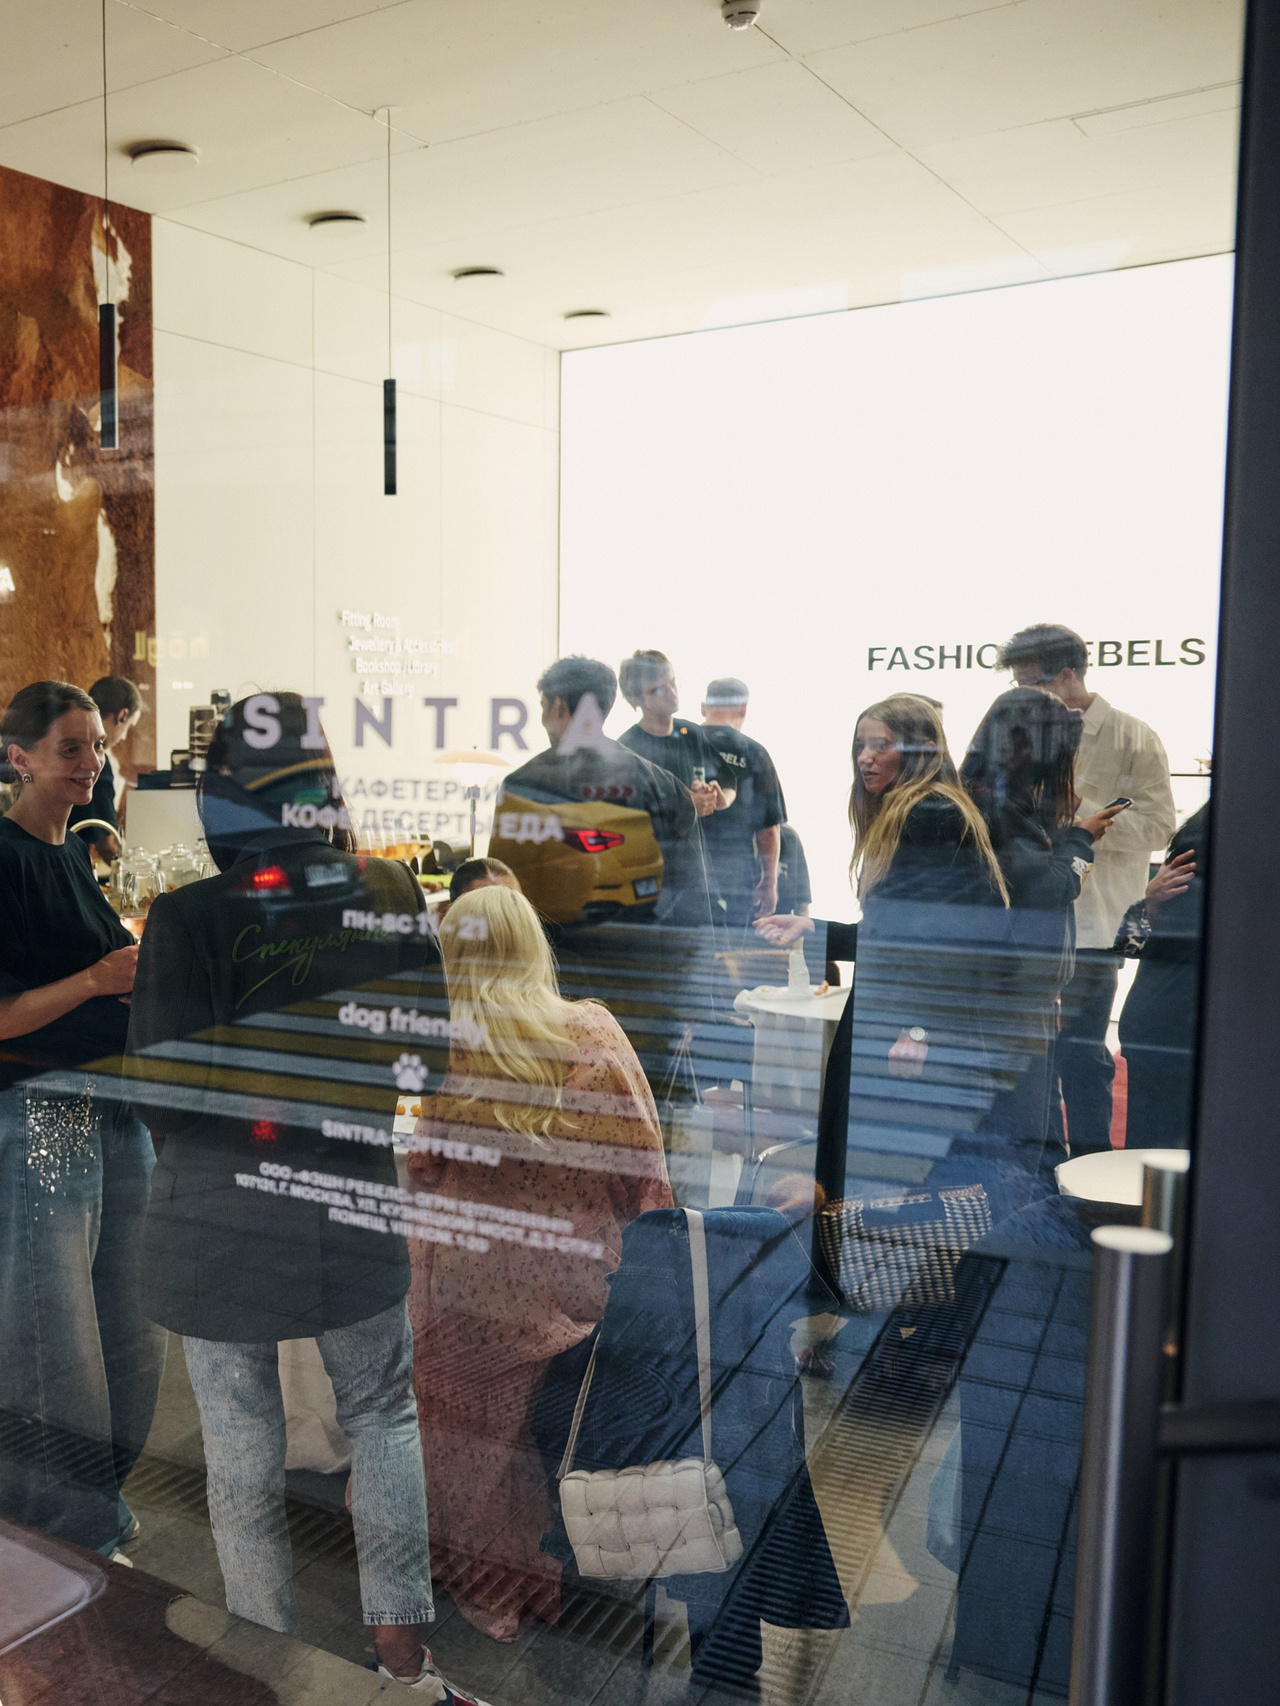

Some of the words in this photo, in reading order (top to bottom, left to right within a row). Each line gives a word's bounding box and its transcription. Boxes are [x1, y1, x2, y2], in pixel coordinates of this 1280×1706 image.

[341, 610, 371, 631] Fitting
[373, 612, 400, 629] Room
[349, 635, 395, 655] Jewellery
[403, 638, 455, 654] Accessories
[867, 643, 999, 671] FASHIO
[1085, 638, 1207, 669] BELS
[355, 658, 401, 675] Bookshop
[407, 659, 438, 677] Library
[363, 681, 380, 695] Art
[380, 681, 414, 697] Gallery
[242, 693, 617, 756] SINTRA
[281, 802, 353, 830] КОФЕ
[361, 808, 496, 839] ДЕСЕРТЫ
[499, 811, 565, 843] ЕДА
[457, 914, 490, 942] 21
[338, 1001, 387, 1035] dog
[389, 1006, 489, 1047] friendly
[259, 1161, 293, 1181] ООО
[289, 1183, 356, 1211] МОСКВА,
